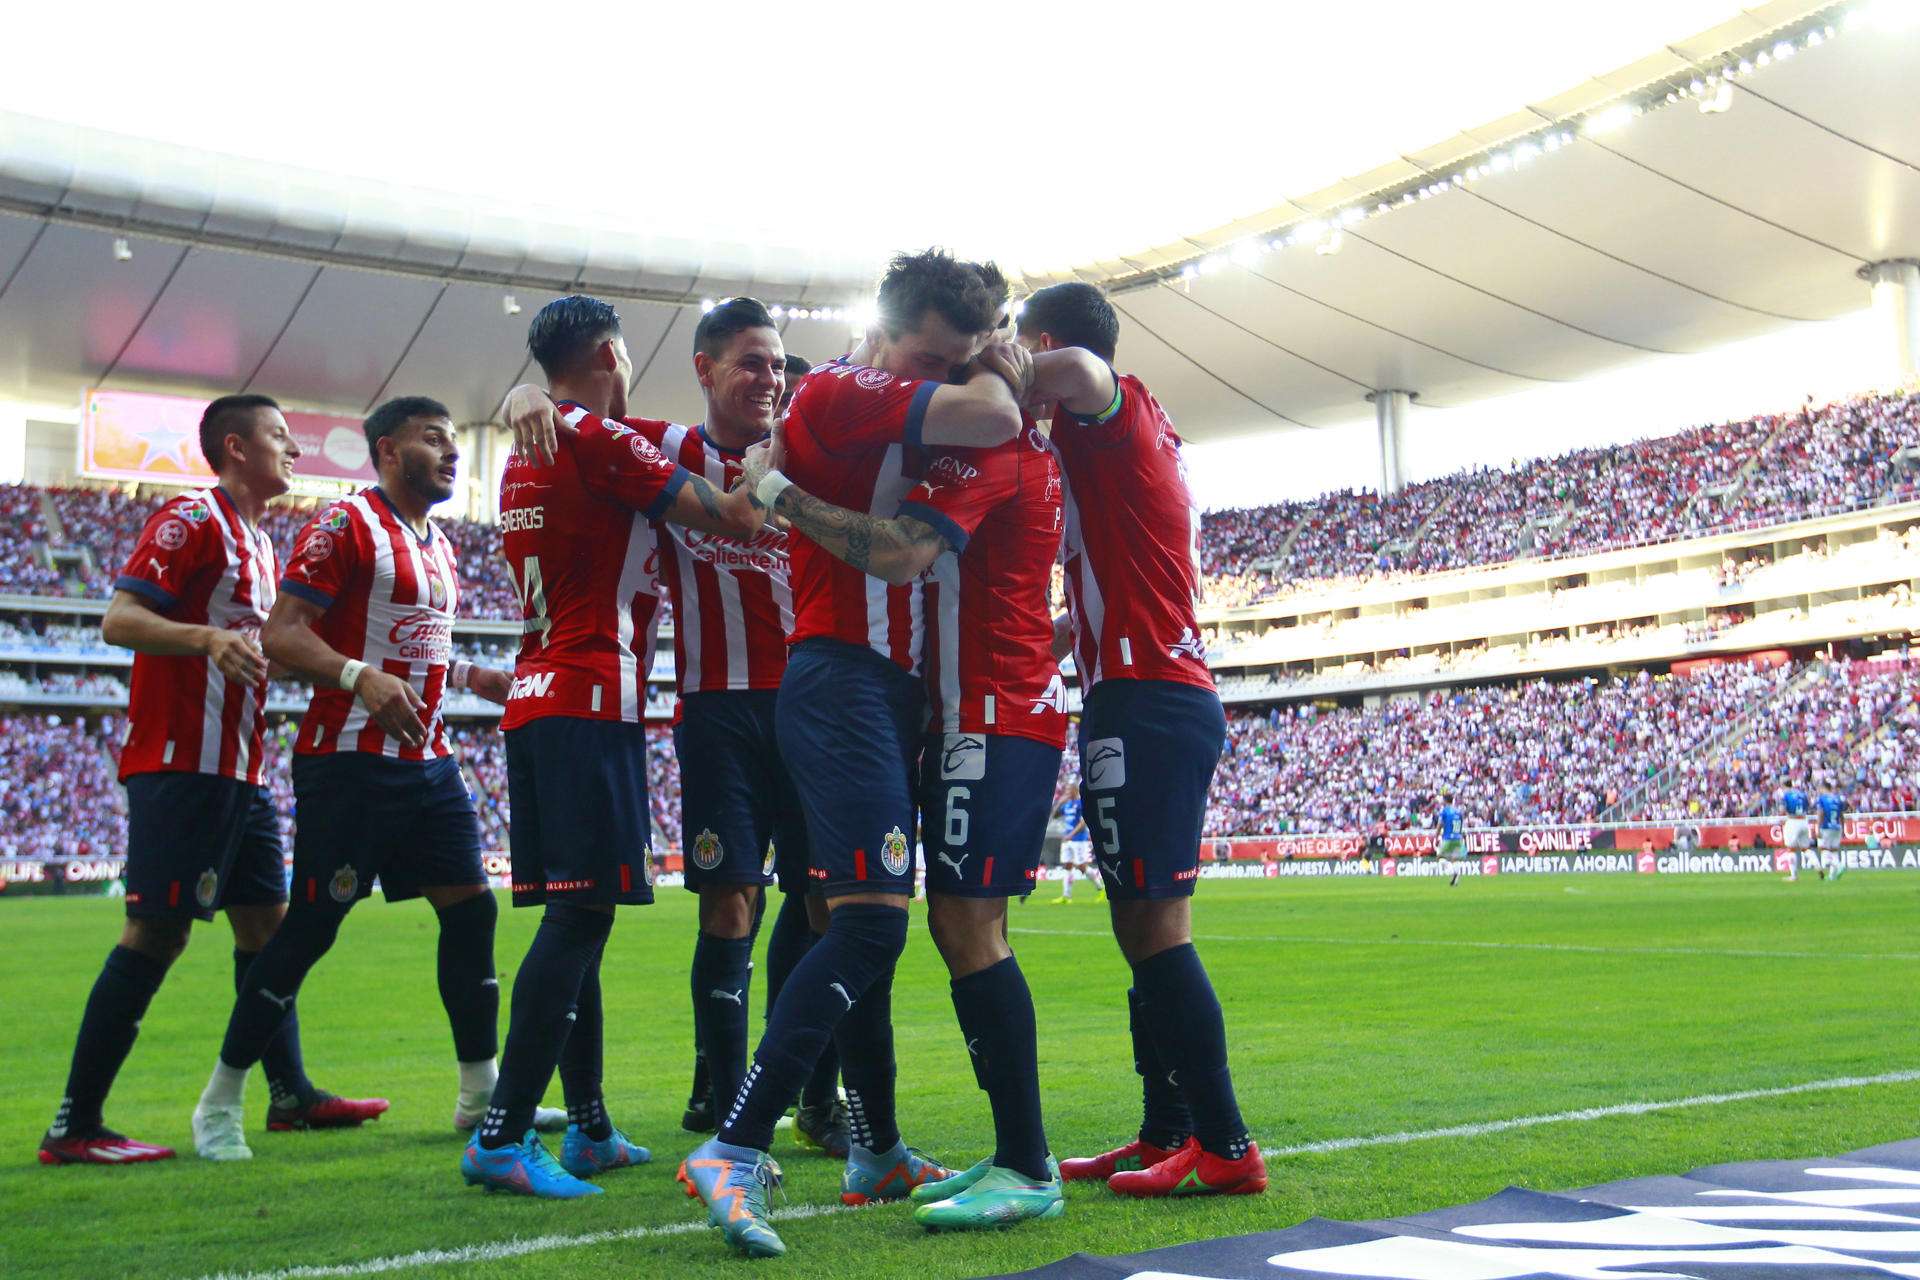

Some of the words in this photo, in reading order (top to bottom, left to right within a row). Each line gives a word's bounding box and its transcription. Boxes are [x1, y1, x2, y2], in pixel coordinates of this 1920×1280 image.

[939, 456, 978, 480] GNP
[944, 786, 971, 846] 6
[1097, 796, 1120, 855] 5
[1277, 838, 1312, 855] GENTE
[1316, 838, 1342, 854] QUE
[1519, 831, 1593, 850] OMNILIFE
[1201, 862, 1265, 877] caliente.mx
[1573, 854, 1632, 872] AHORA!
[1657, 852, 1772, 873] caliente.mx
